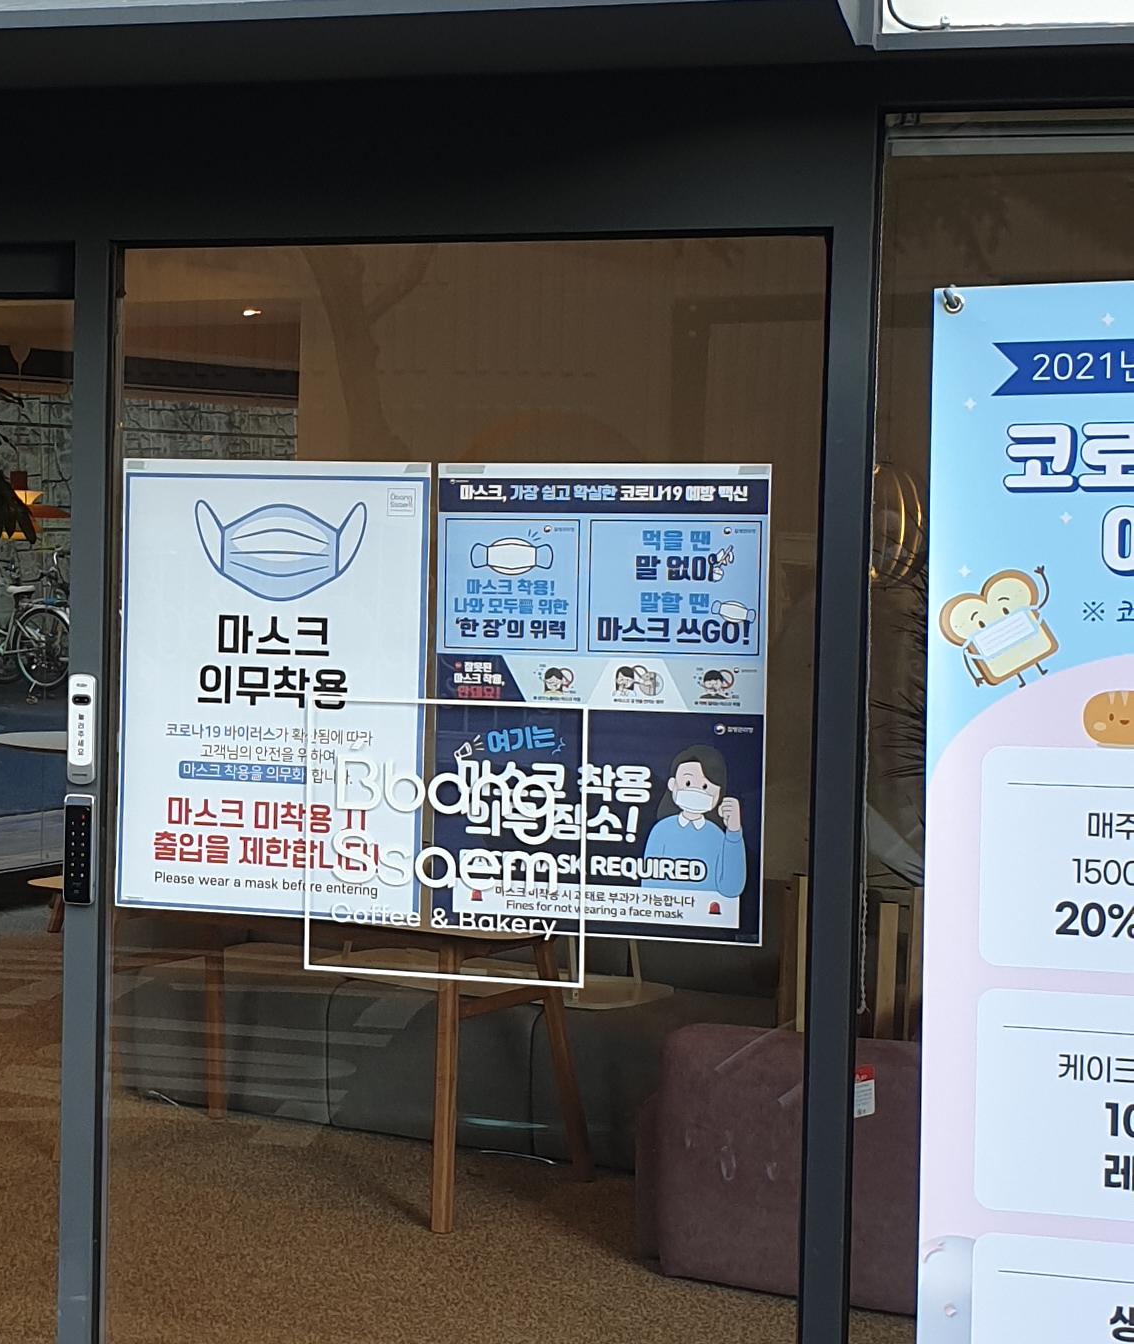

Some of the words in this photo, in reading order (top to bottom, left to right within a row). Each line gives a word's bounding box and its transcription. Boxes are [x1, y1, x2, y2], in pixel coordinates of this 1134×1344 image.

[509, 485, 539, 501] 가장
[541, 485, 570, 501] 쉽고
[642, 529, 684, 551] 먹을
[690, 529, 711, 552] 땐
[636, 555, 661, 581] 말
[466, 578, 513, 596] 마스크
[516, 578, 555, 596] 착용!
[454, 598, 485, 614] 나와
[487, 597, 534, 615] 모두를
[537, 598, 569, 615] 위한
[640, 591, 683, 614] 말할
[688, 592, 710, 615] 땐
[217, 614, 330, 657] 마스크
[529, 619, 566, 640] 위력
[598, 616, 670, 643] 마스크
[197, 664, 348, 711] 의무착용
[165, 722, 221, 740] 코로나19
[224, 725, 289, 743] 바이러스가
[486, 725, 556, 754] 여기는
[200, 744, 252, 761] 고객님의
[255, 745, 294, 763] 안전을
[182, 762, 221, 778] 마스크
[224, 764, 263, 781] 착용을
[577, 763, 653, 803] 착용
[166, 797, 245, 828] 마스크
[254, 801, 332, 834] 미착용
[153, 830, 230, 865] 출입을
[331, 827, 558, 892] Ssaem
[590, 855, 707, 882] REQUIRED
[154, 871, 195, 886] Please
[198, 875, 230, 888] wear
[233, 878, 241, 888] a
[245, 876, 279, 891] mask
[326, 882, 378, 899] entering
[494, 885, 527, 898] 마스크
[562, 891, 572, 901] 시
[608, 892, 640, 905] 부과가
[642, 893, 695, 908] 가능합니다
[330, 902, 421, 928] Coffee
[430, 906, 448, 929] &
[458, 910, 558, 941] Bakery
[506, 899, 534, 911] Fines
[536, 901, 553, 912] for
[554, 903, 573, 914] not
[619, 908, 626, 916] a
[629, 906, 652, 917] face
[654, 908, 684, 919] mask
[1054, 900, 1134, 940] 20%
